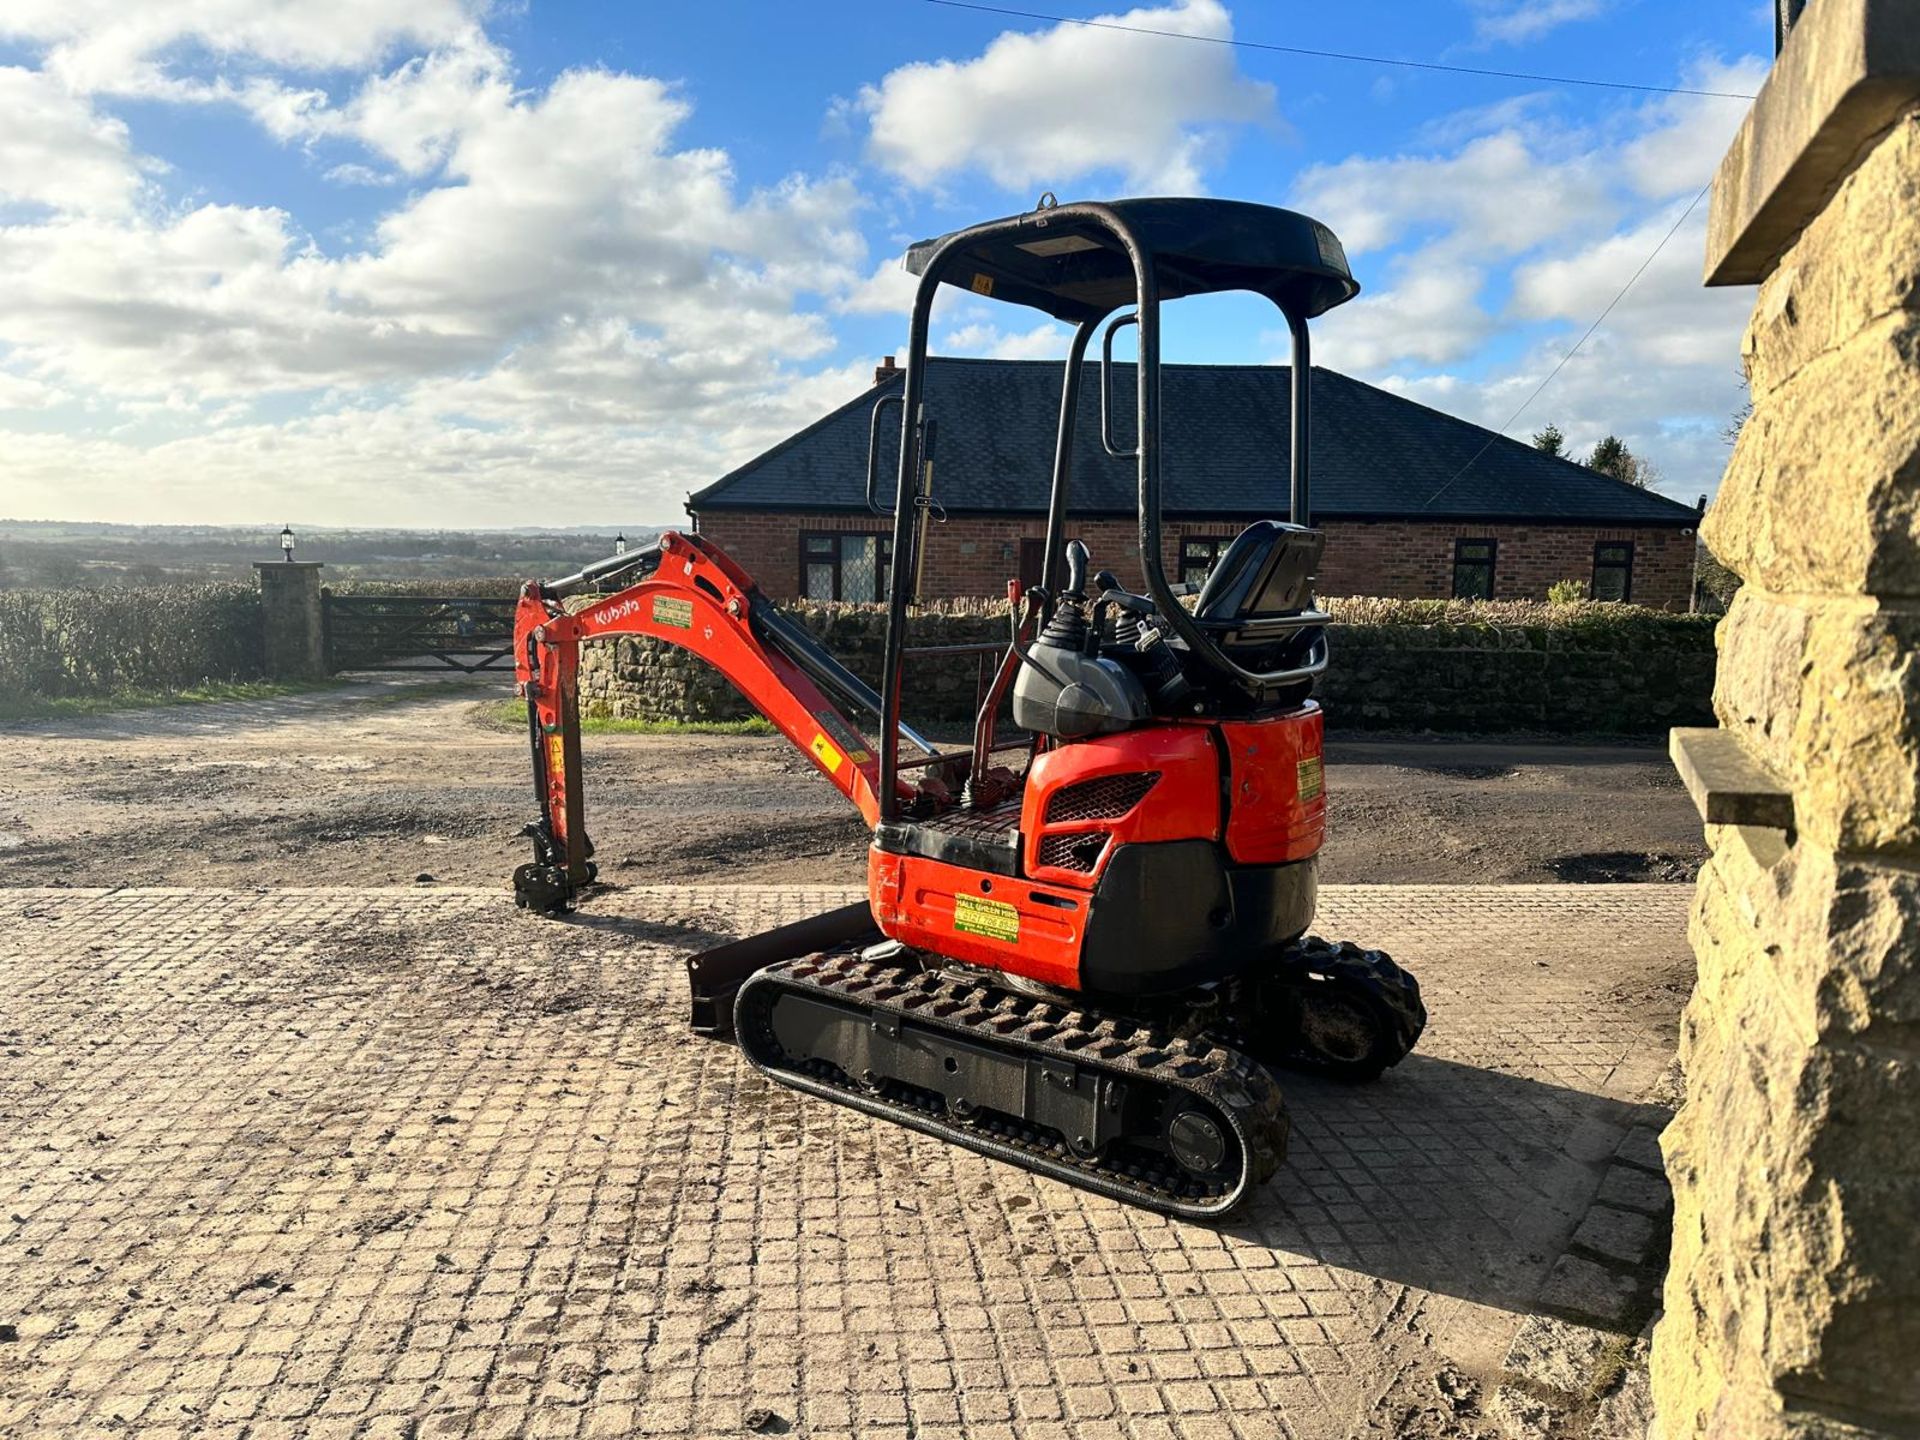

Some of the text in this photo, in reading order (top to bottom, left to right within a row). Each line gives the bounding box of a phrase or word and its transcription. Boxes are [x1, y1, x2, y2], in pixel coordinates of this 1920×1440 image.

[594, 600, 640, 625] Kubota
[956, 899, 973, 911] HALL
[975, 903, 1000, 915] GREEN
